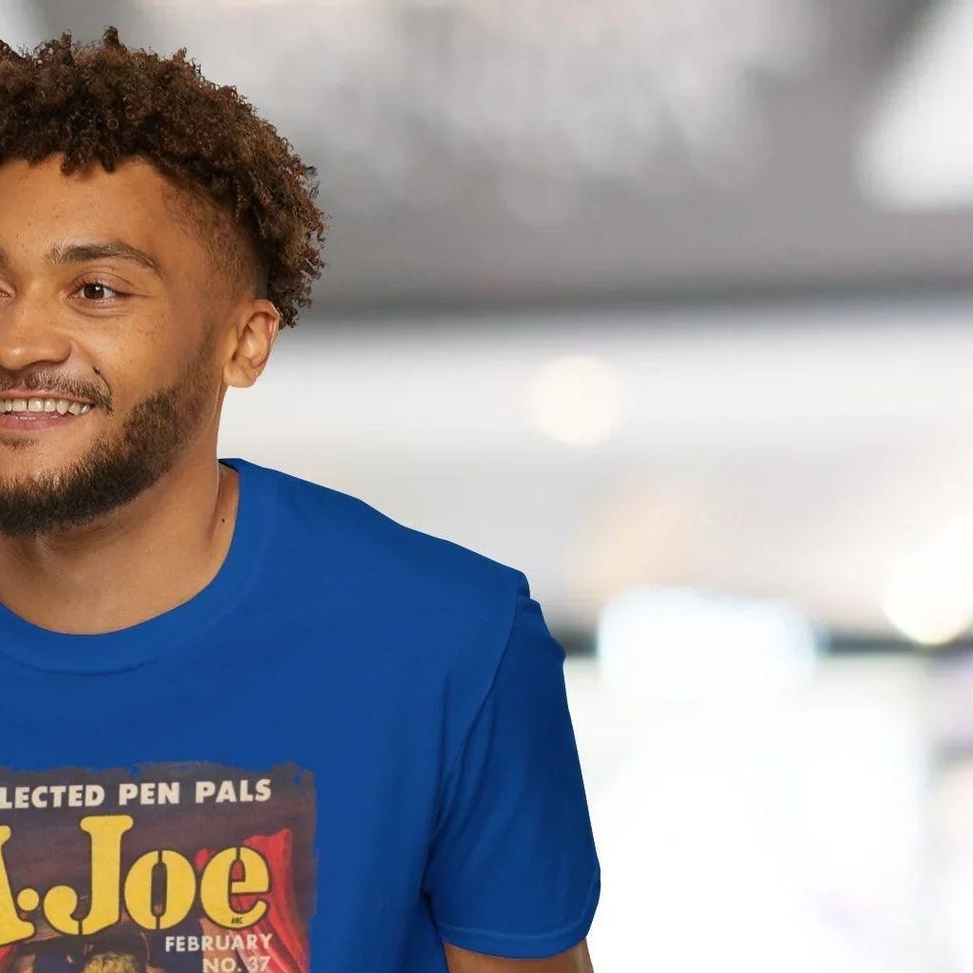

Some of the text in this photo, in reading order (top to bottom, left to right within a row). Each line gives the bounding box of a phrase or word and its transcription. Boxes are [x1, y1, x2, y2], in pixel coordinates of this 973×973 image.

[119, 782, 180, 806] PEN
[195, 779, 272, 803] PALS
[165, 934, 272, 952] FEBRUARY
[203, 956, 270, 973] NO. 37
